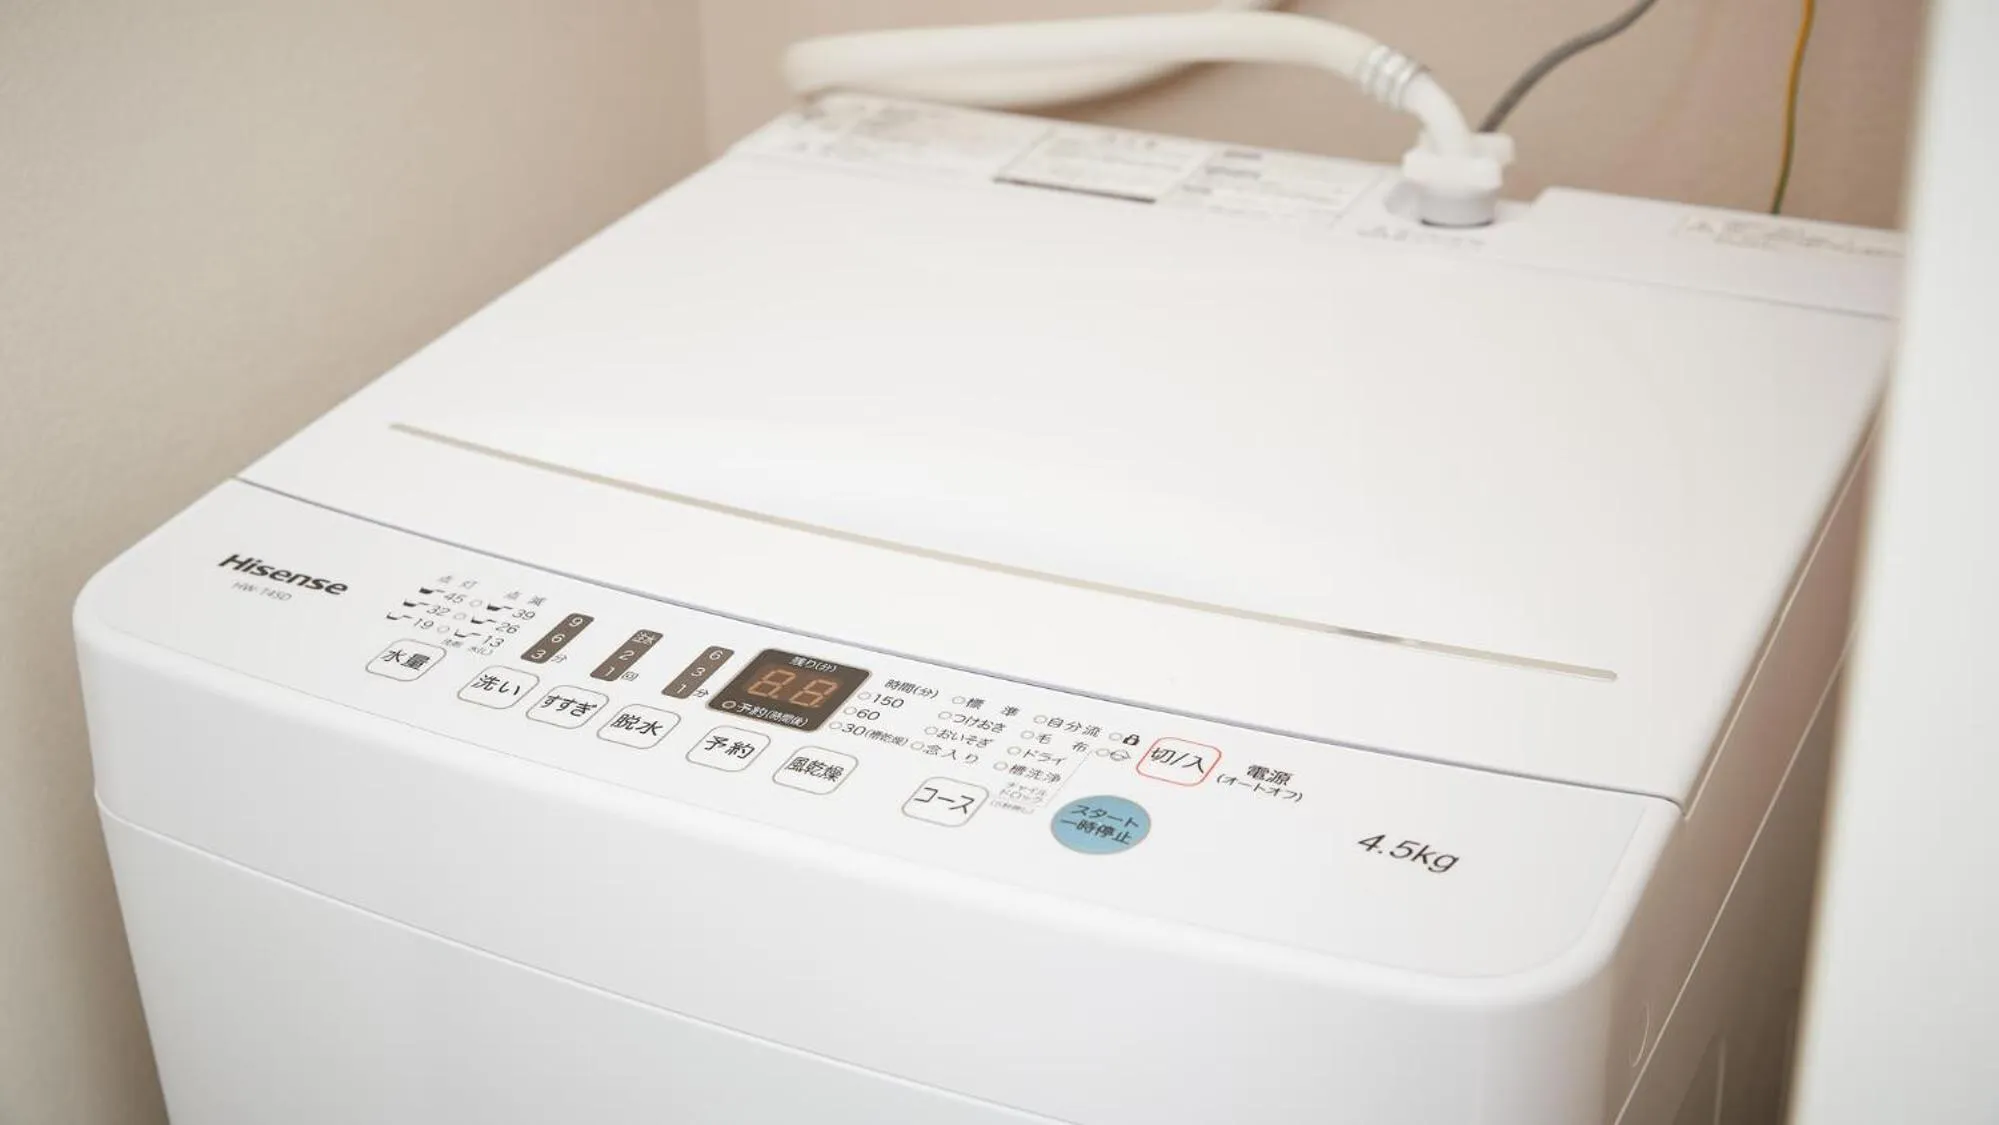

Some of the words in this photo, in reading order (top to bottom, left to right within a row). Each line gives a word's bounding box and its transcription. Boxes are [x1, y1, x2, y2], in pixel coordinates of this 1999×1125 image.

[217, 554, 348, 595] Hisense
[444, 592, 467, 605] 45
[512, 608, 536, 621] 39
[426, 604, 451, 617] 32
[495, 621, 521, 634] 26
[569, 616, 584, 628] 9
[413, 617, 435, 630] 19
[482, 635, 506, 648] 13
[552, 633, 566, 644] 6
[380, 649, 431, 671] 水量
[531, 650, 546, 660] 3
[618, 650, 634, 661] 2
[709, 650, 724, 661] 6
[471, 673, 521, 696] 洗い
[691, 667, 706, 678] 3
[541, 693, 598, 718] すすぎ
[873, 694, 905, 709] 150
[610, 713, 664, 737] 脱水
[856, 708, 881, 721] 60
[704, 735, 756, 760] 予約
[785, 756, 845, 782] 風乾燥
[1151, 747, 1205, 774] 切/入
[1246, 764, 1294, 787] 電源
[914, 787, 976, 815] コース
[1070, 803, 1140, 829] スタート
[1060, 818, 1132, 846] 一時停止
[1358, 833, 1460, 875] 4.5kg
